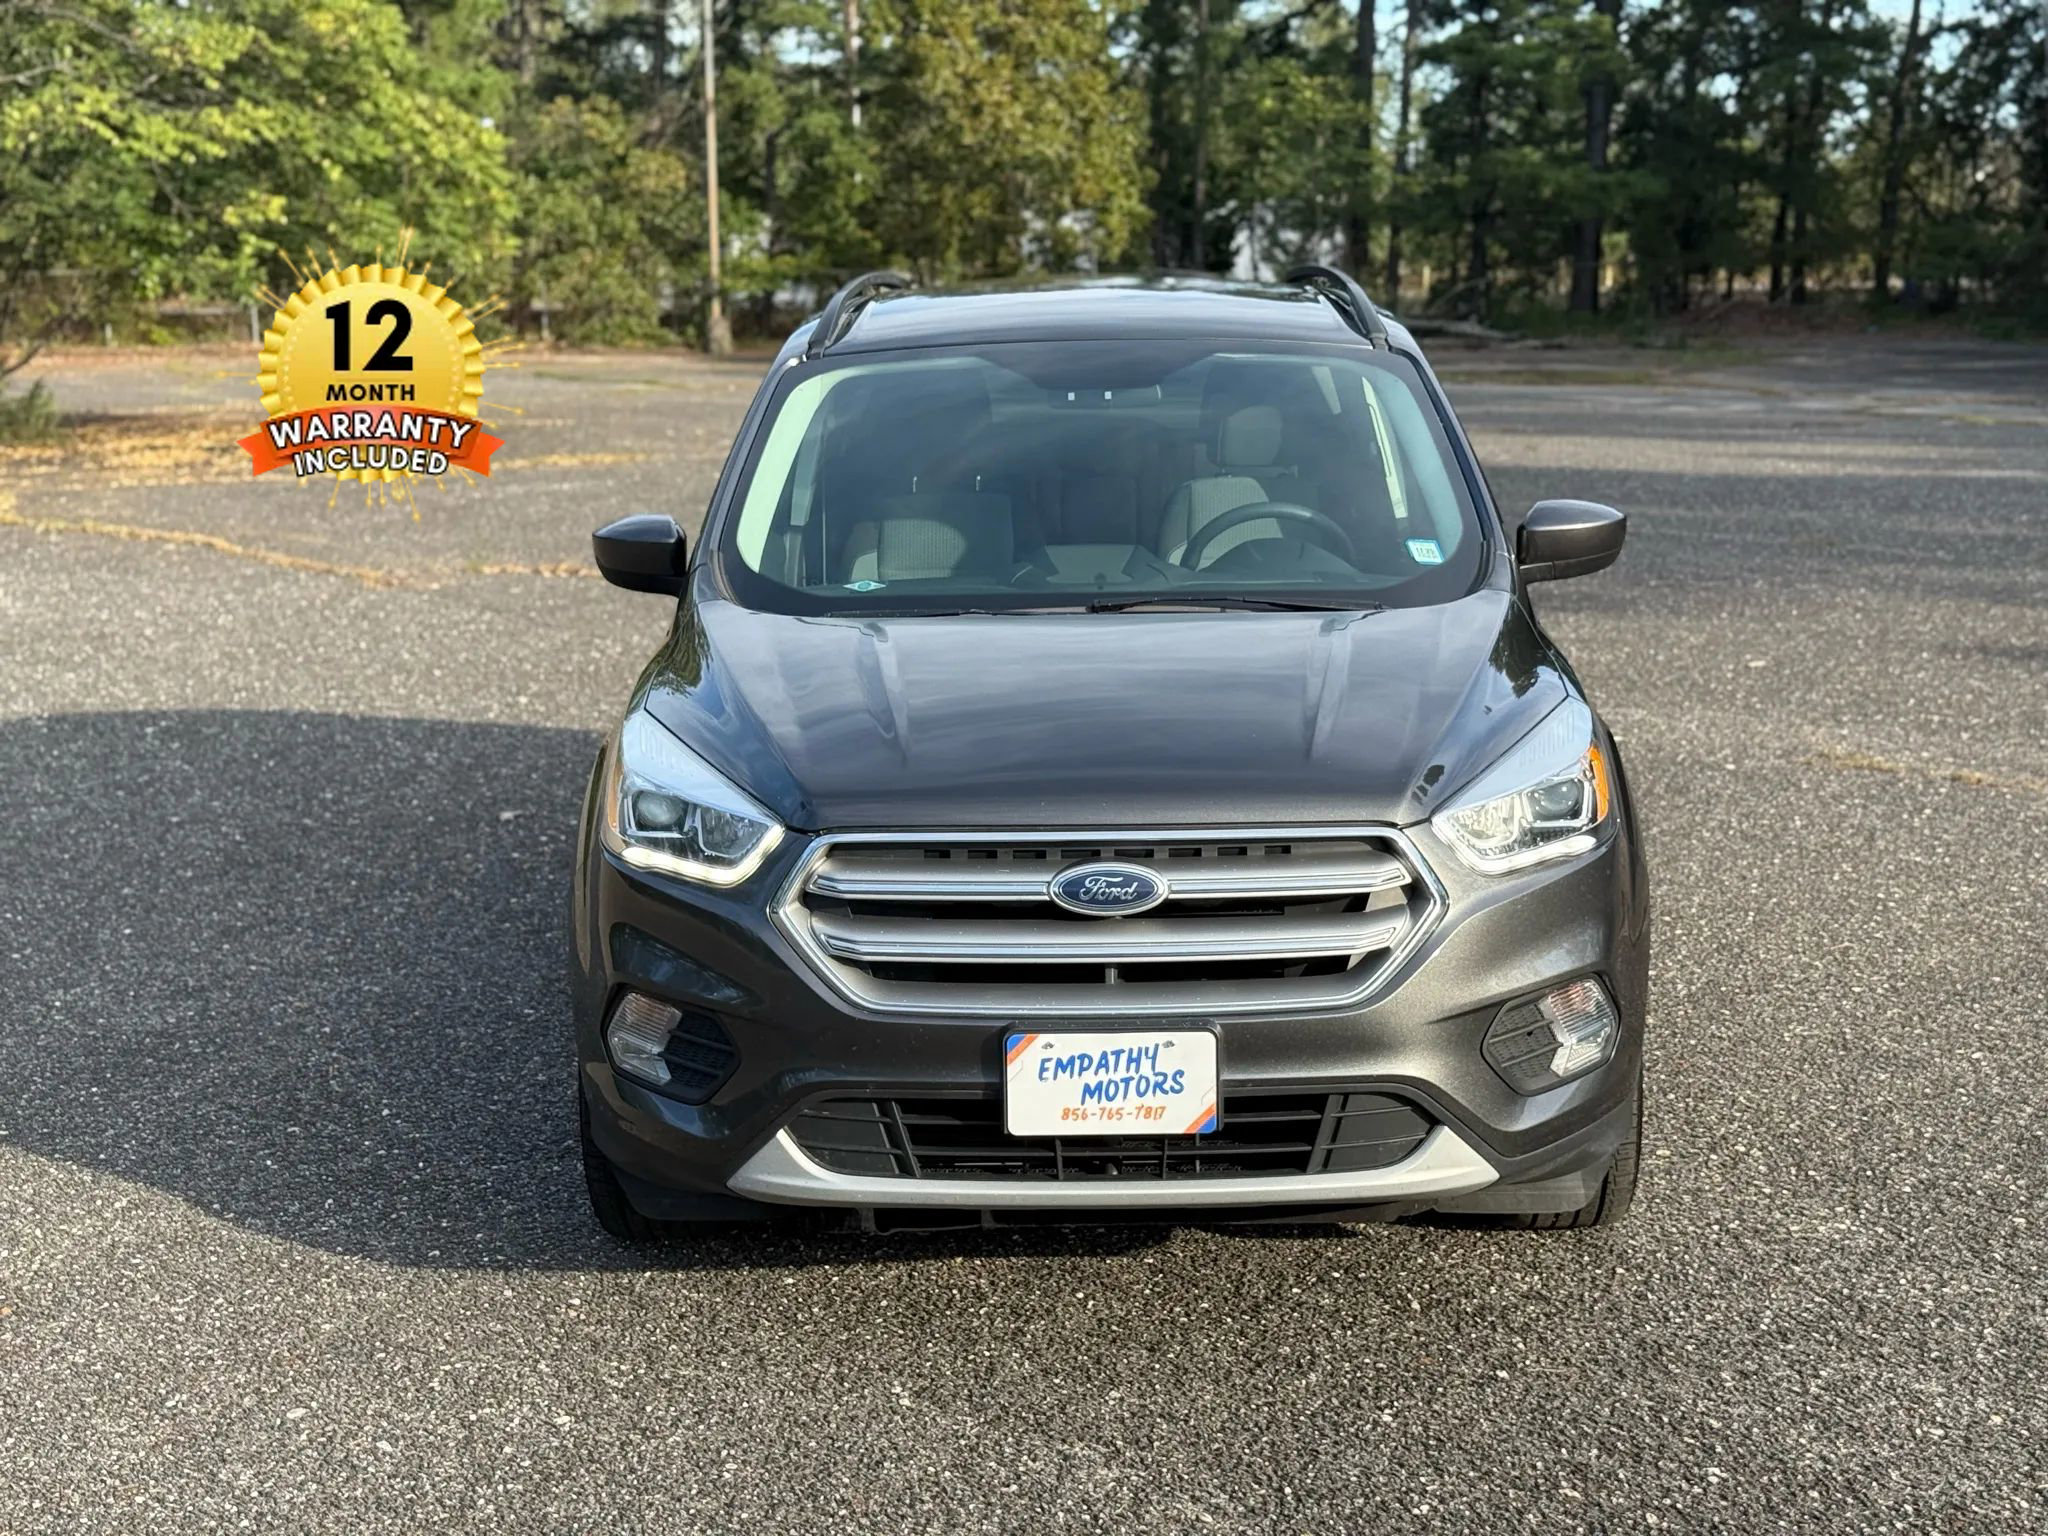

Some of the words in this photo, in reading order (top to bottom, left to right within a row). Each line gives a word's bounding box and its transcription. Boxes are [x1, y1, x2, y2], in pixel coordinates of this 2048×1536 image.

[1079, 876, 1138, 901] Ford
[1038, 1043, 1159, 1082] EMPATHY
[1081, 1069, 1185, 1106] MOTORS
[1061, 1104, 1166, 1121] 856-765-7817
